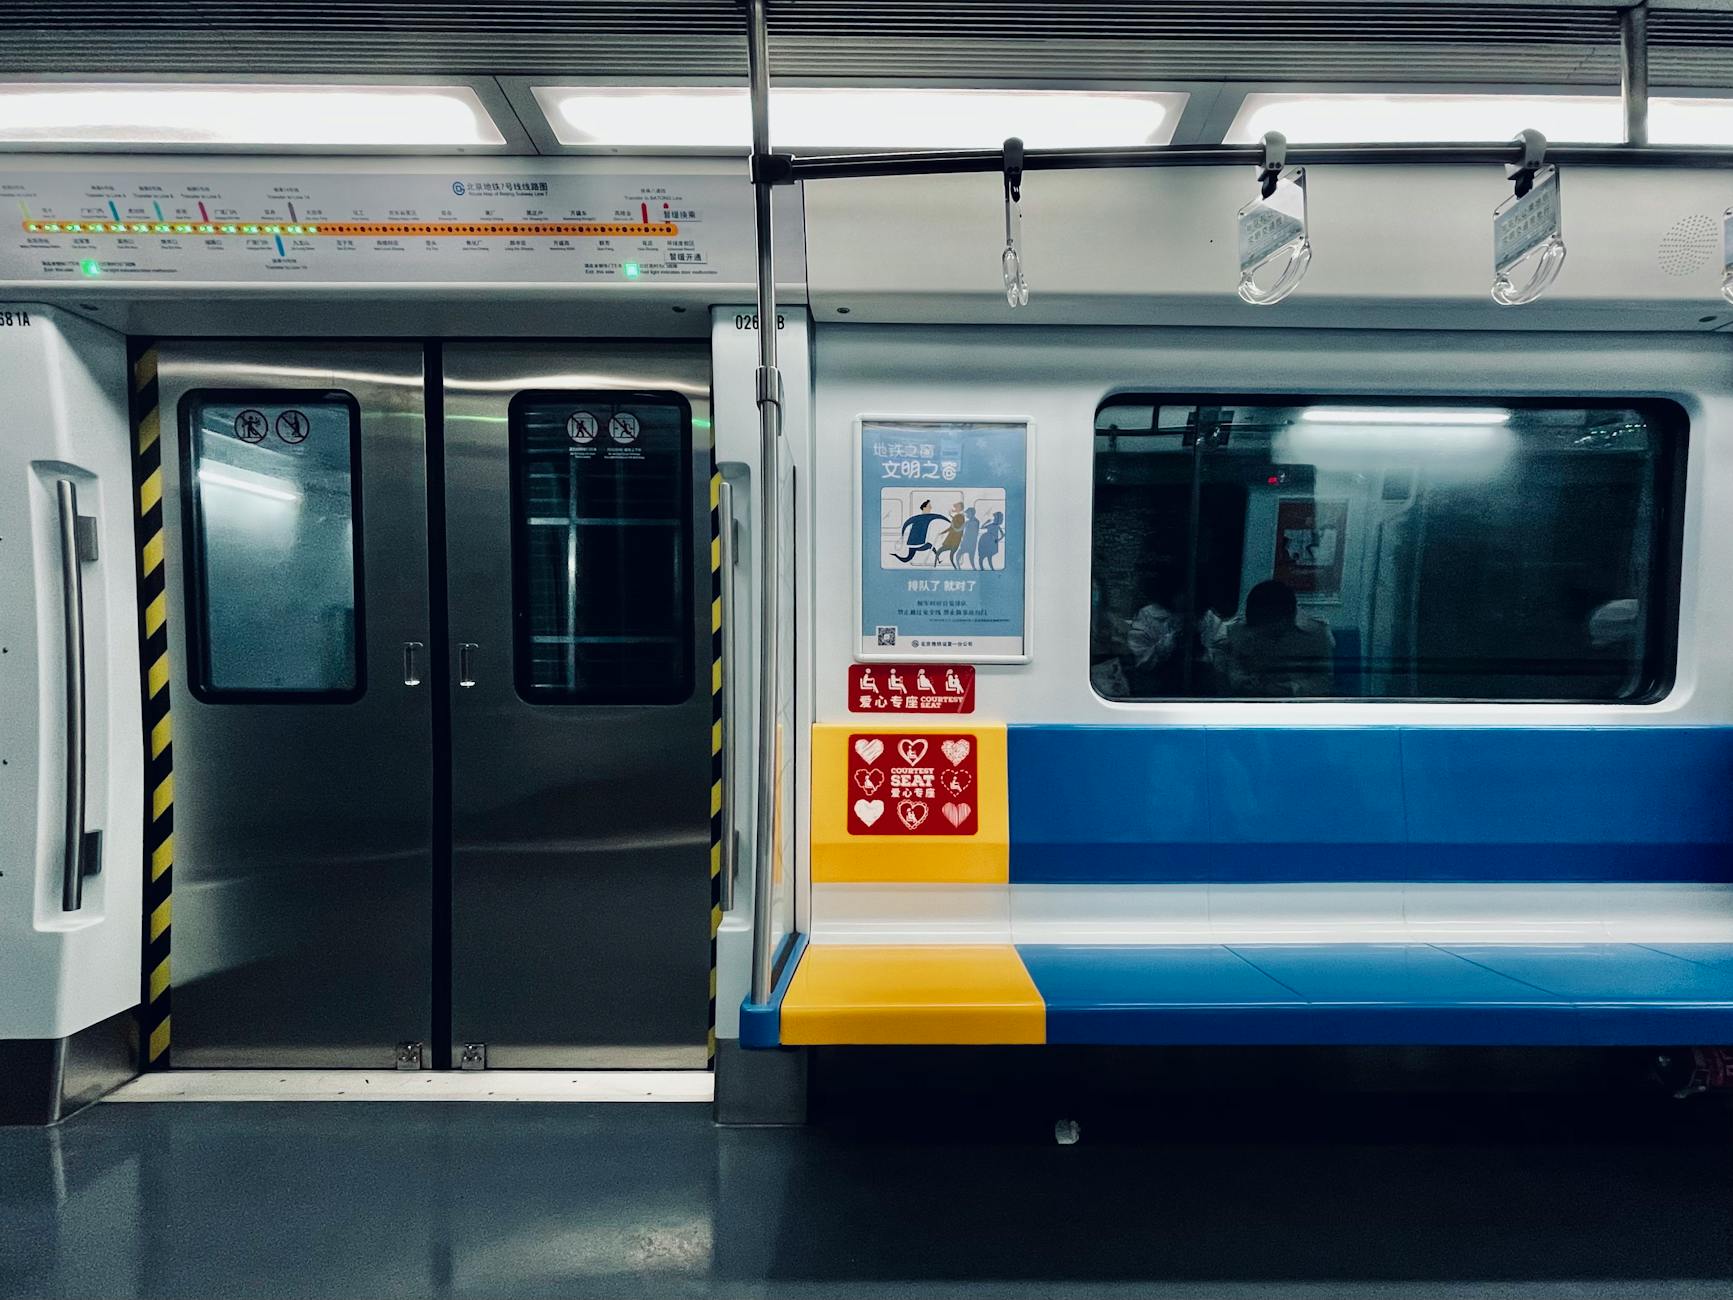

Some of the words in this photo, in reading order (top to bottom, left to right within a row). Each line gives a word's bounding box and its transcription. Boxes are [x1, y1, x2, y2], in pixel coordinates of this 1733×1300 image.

[669, 253, 702, 262] 暂缓开通
[736, 314, 785, 330] 026B
[859, 695, 918, 709] 爱心专座
[920, 696, 963, 704] COURTESY
[890, 767, 935, 775] COURTESY
[890, 774, 935, 787] SEAT
[890, 787, 936, 799] 爱心专座
